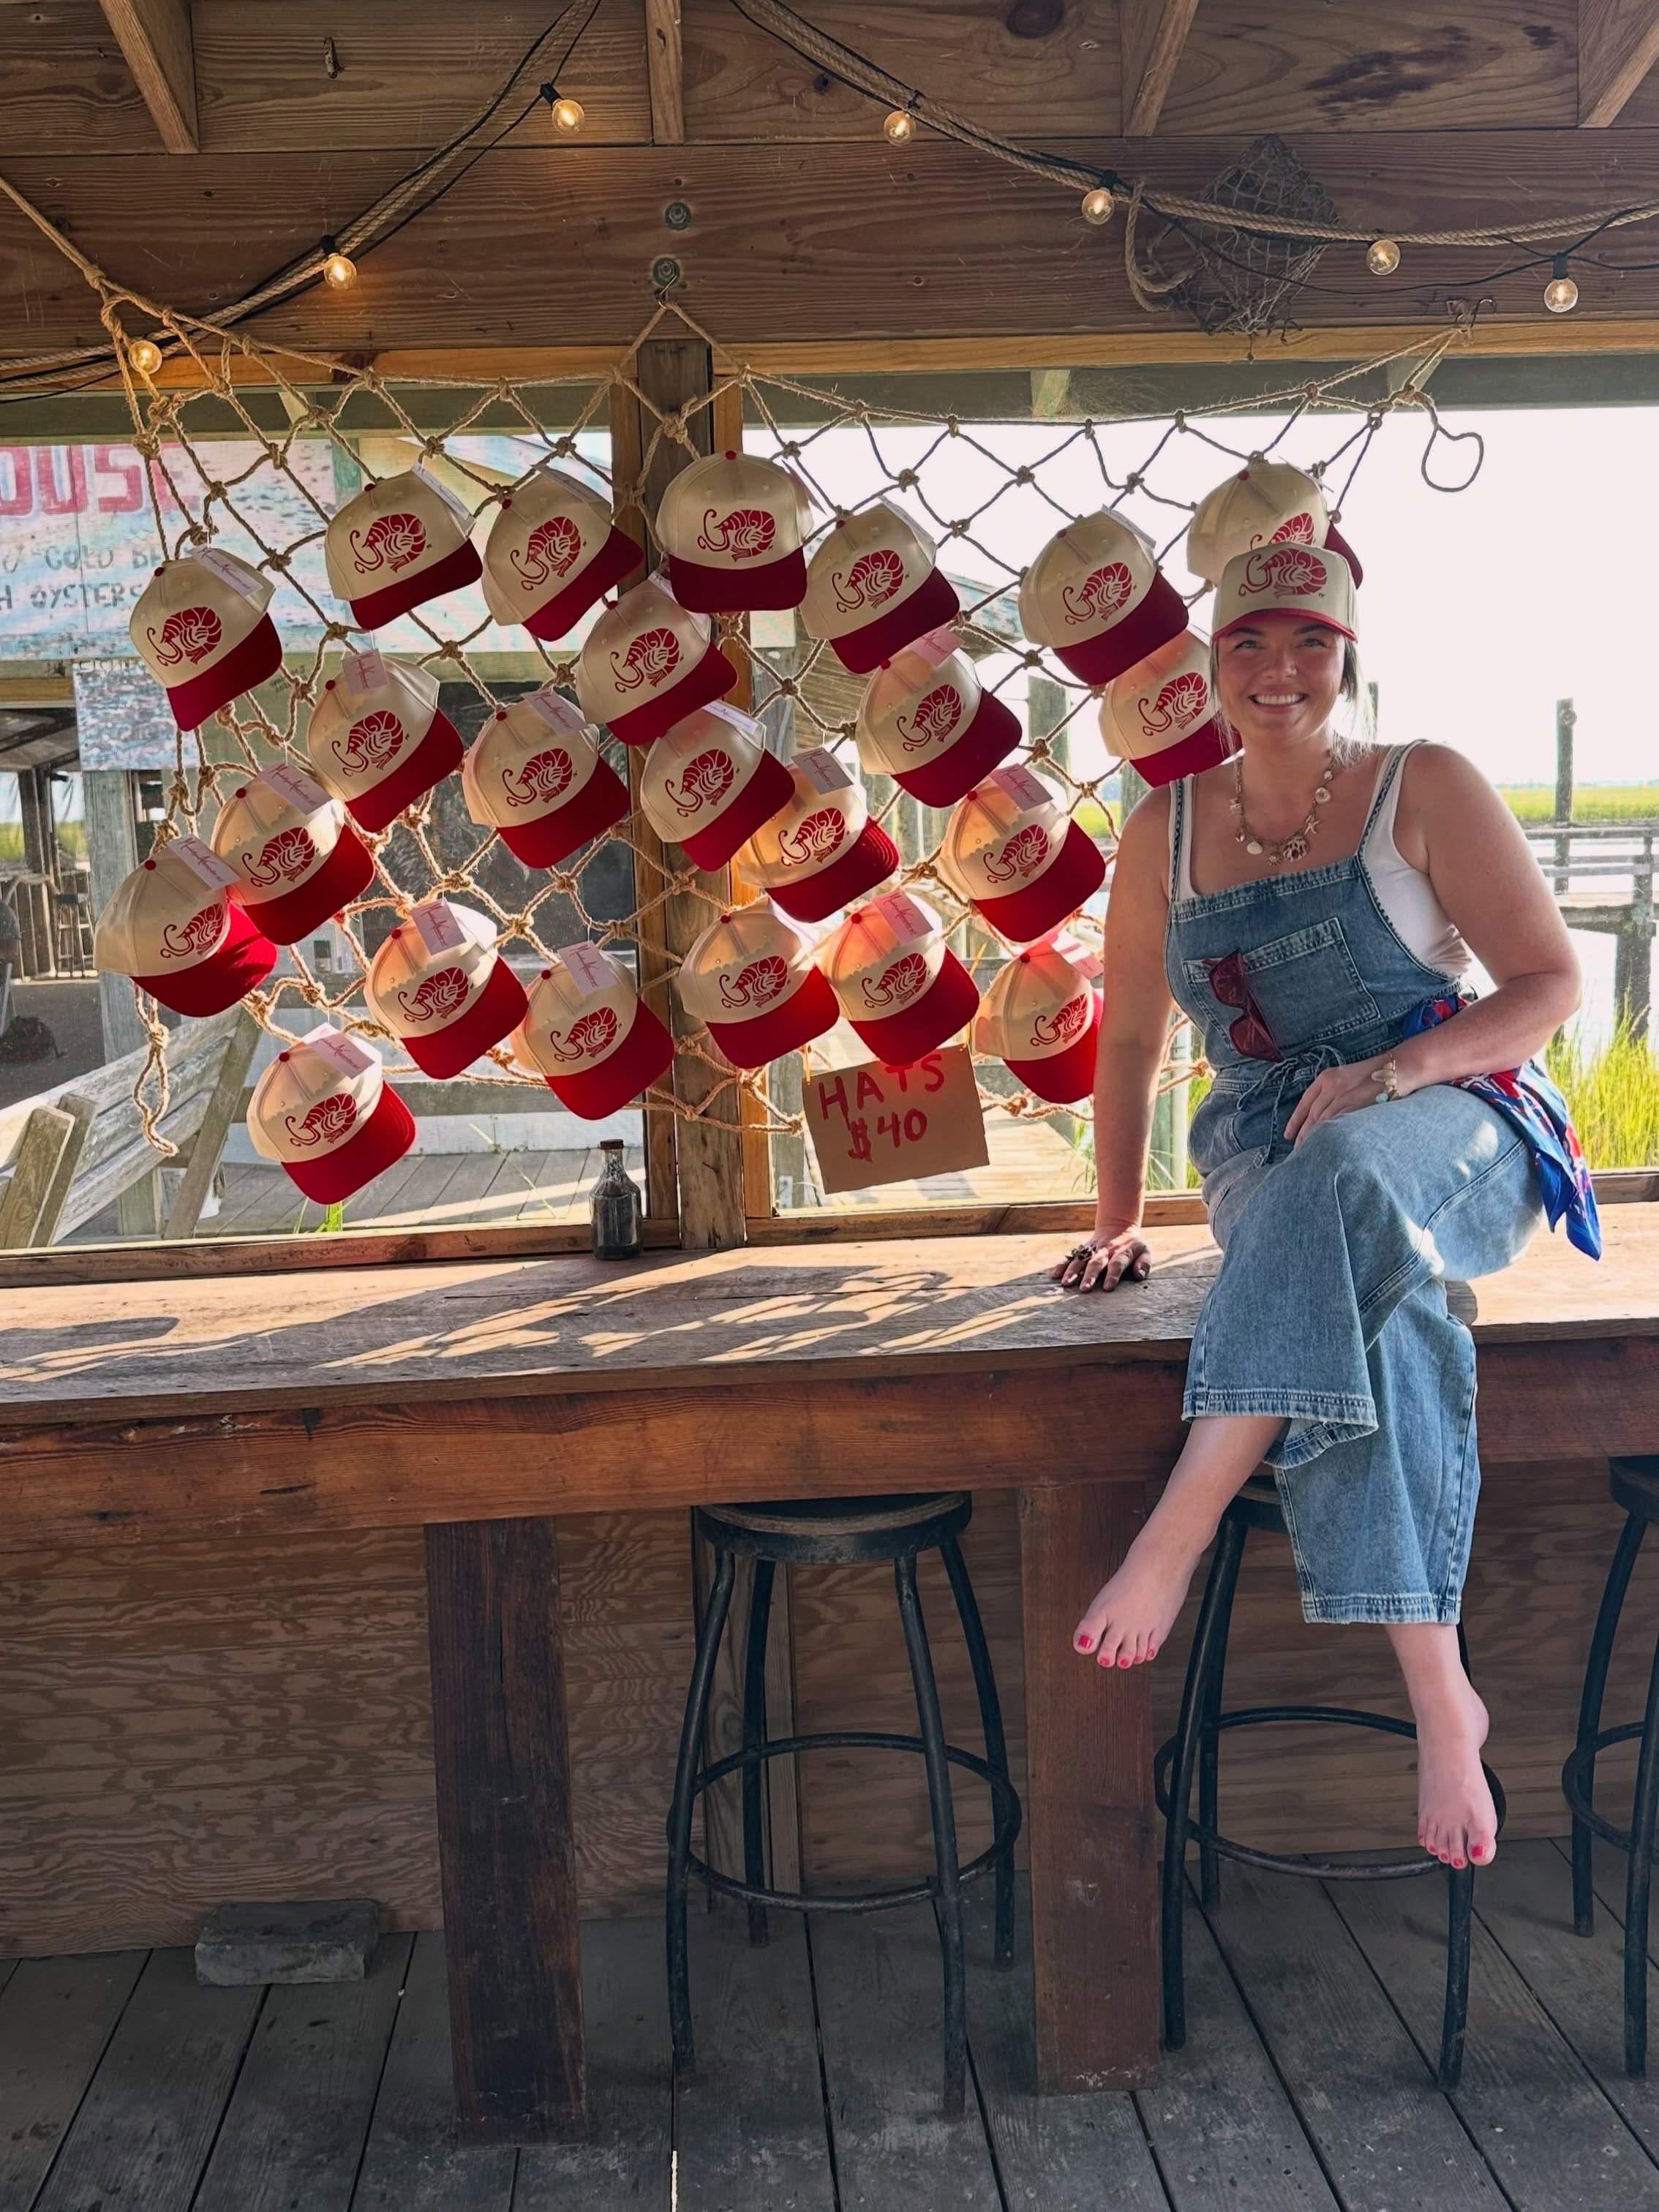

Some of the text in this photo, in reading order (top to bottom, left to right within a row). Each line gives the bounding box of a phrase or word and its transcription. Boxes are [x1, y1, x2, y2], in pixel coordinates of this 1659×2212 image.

[45, 546, 114, 571] COLD
[818, 1054, 944, 1127] HATS
[848, 1108, 928, 1162] $40
